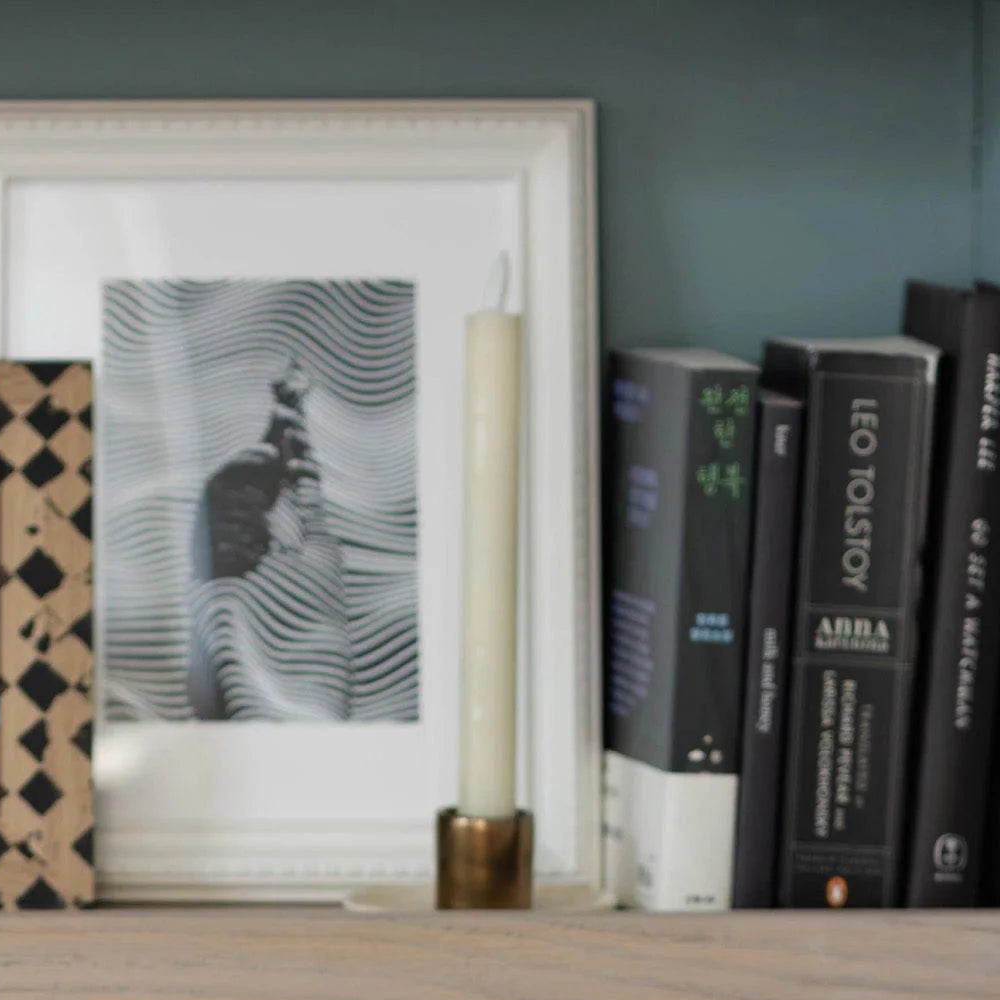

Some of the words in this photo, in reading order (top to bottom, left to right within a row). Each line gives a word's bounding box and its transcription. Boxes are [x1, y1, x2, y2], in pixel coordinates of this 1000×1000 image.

[849, 398, 879, 457] LEO
[841, 466, 876, 592] TOLSTOY
[971, 518, 991, 548] GO
[967, 552, 987, 592] SET
[964, 592, 982, 610] A
